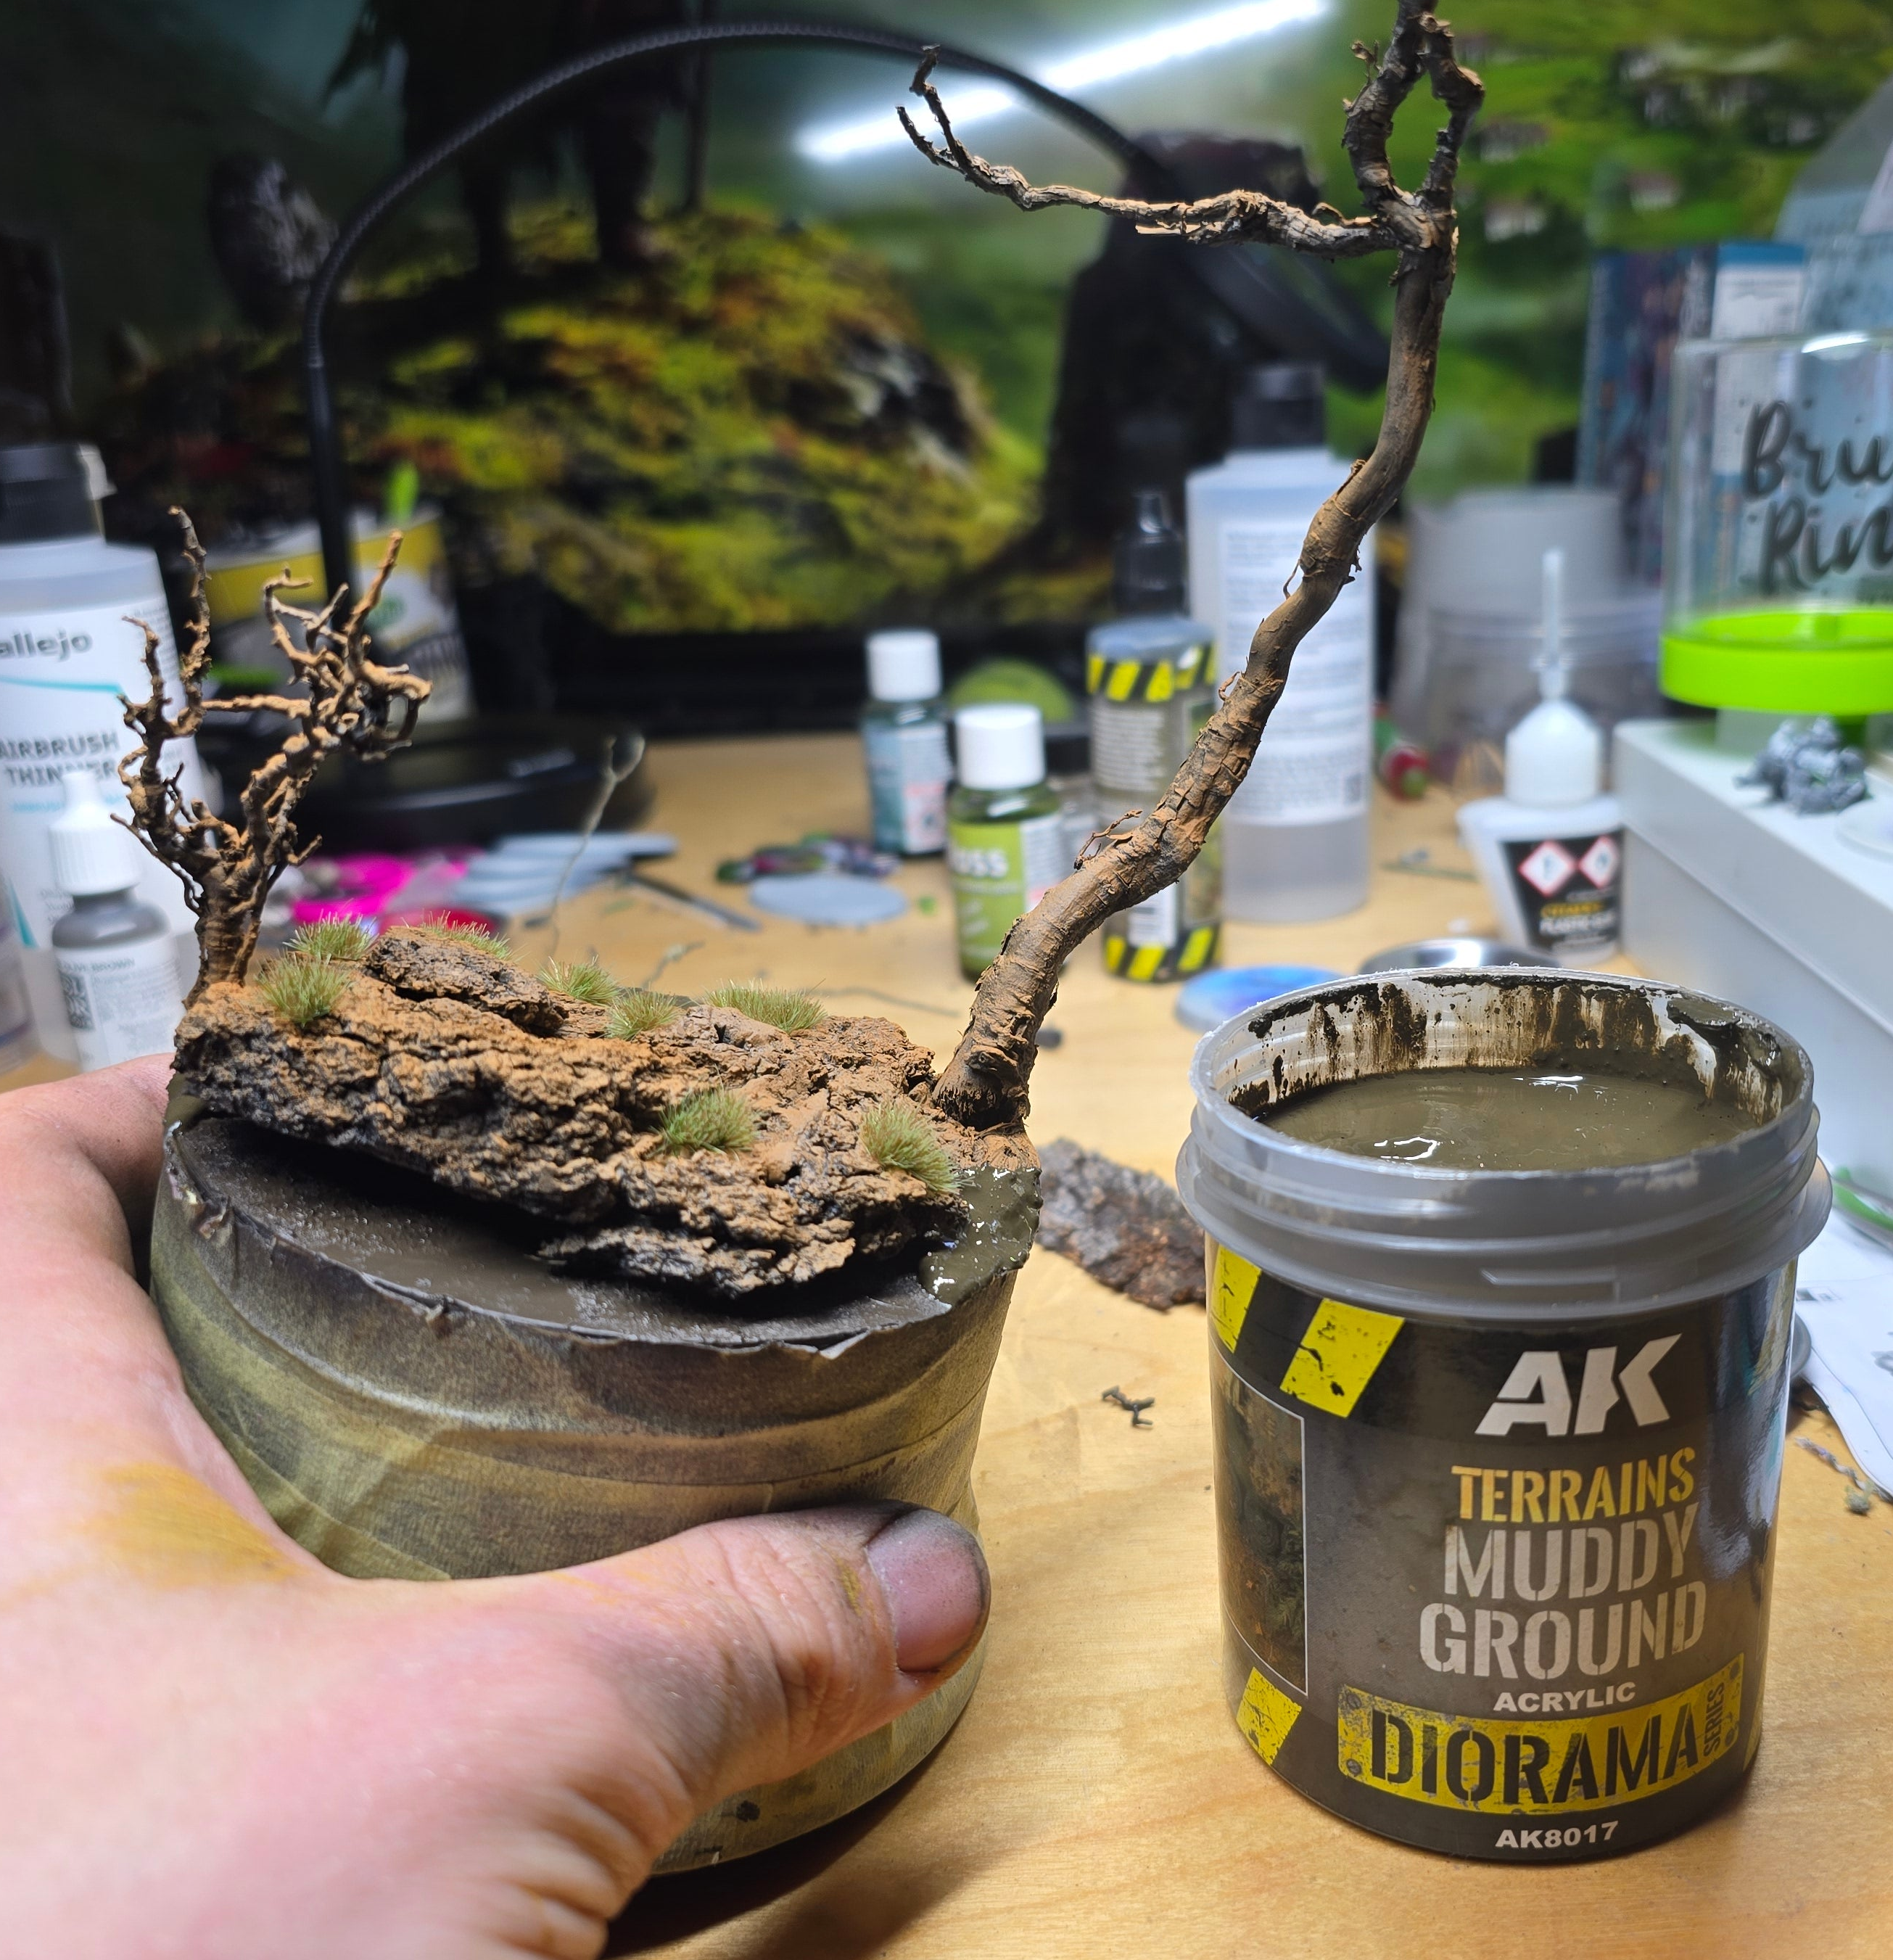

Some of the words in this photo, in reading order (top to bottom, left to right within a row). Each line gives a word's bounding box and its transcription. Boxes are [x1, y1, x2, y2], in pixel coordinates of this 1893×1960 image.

[1475, 1334, 1683, 1436] AK
[1451, 1447, 1696, 1523] TERRAINS
[1445, 1502, 1699, 1602] MUDDY
[1419, 1581, 1706, 1680] GROUND
[1372, 1704, 1699, 1804] DIORAMA
[1703, 1683, 1725, 1756] SERIES
[1493, 1681, 1636, 1713] ACRYLIC
[1495, 1821, 1620, 1849] AK8017
